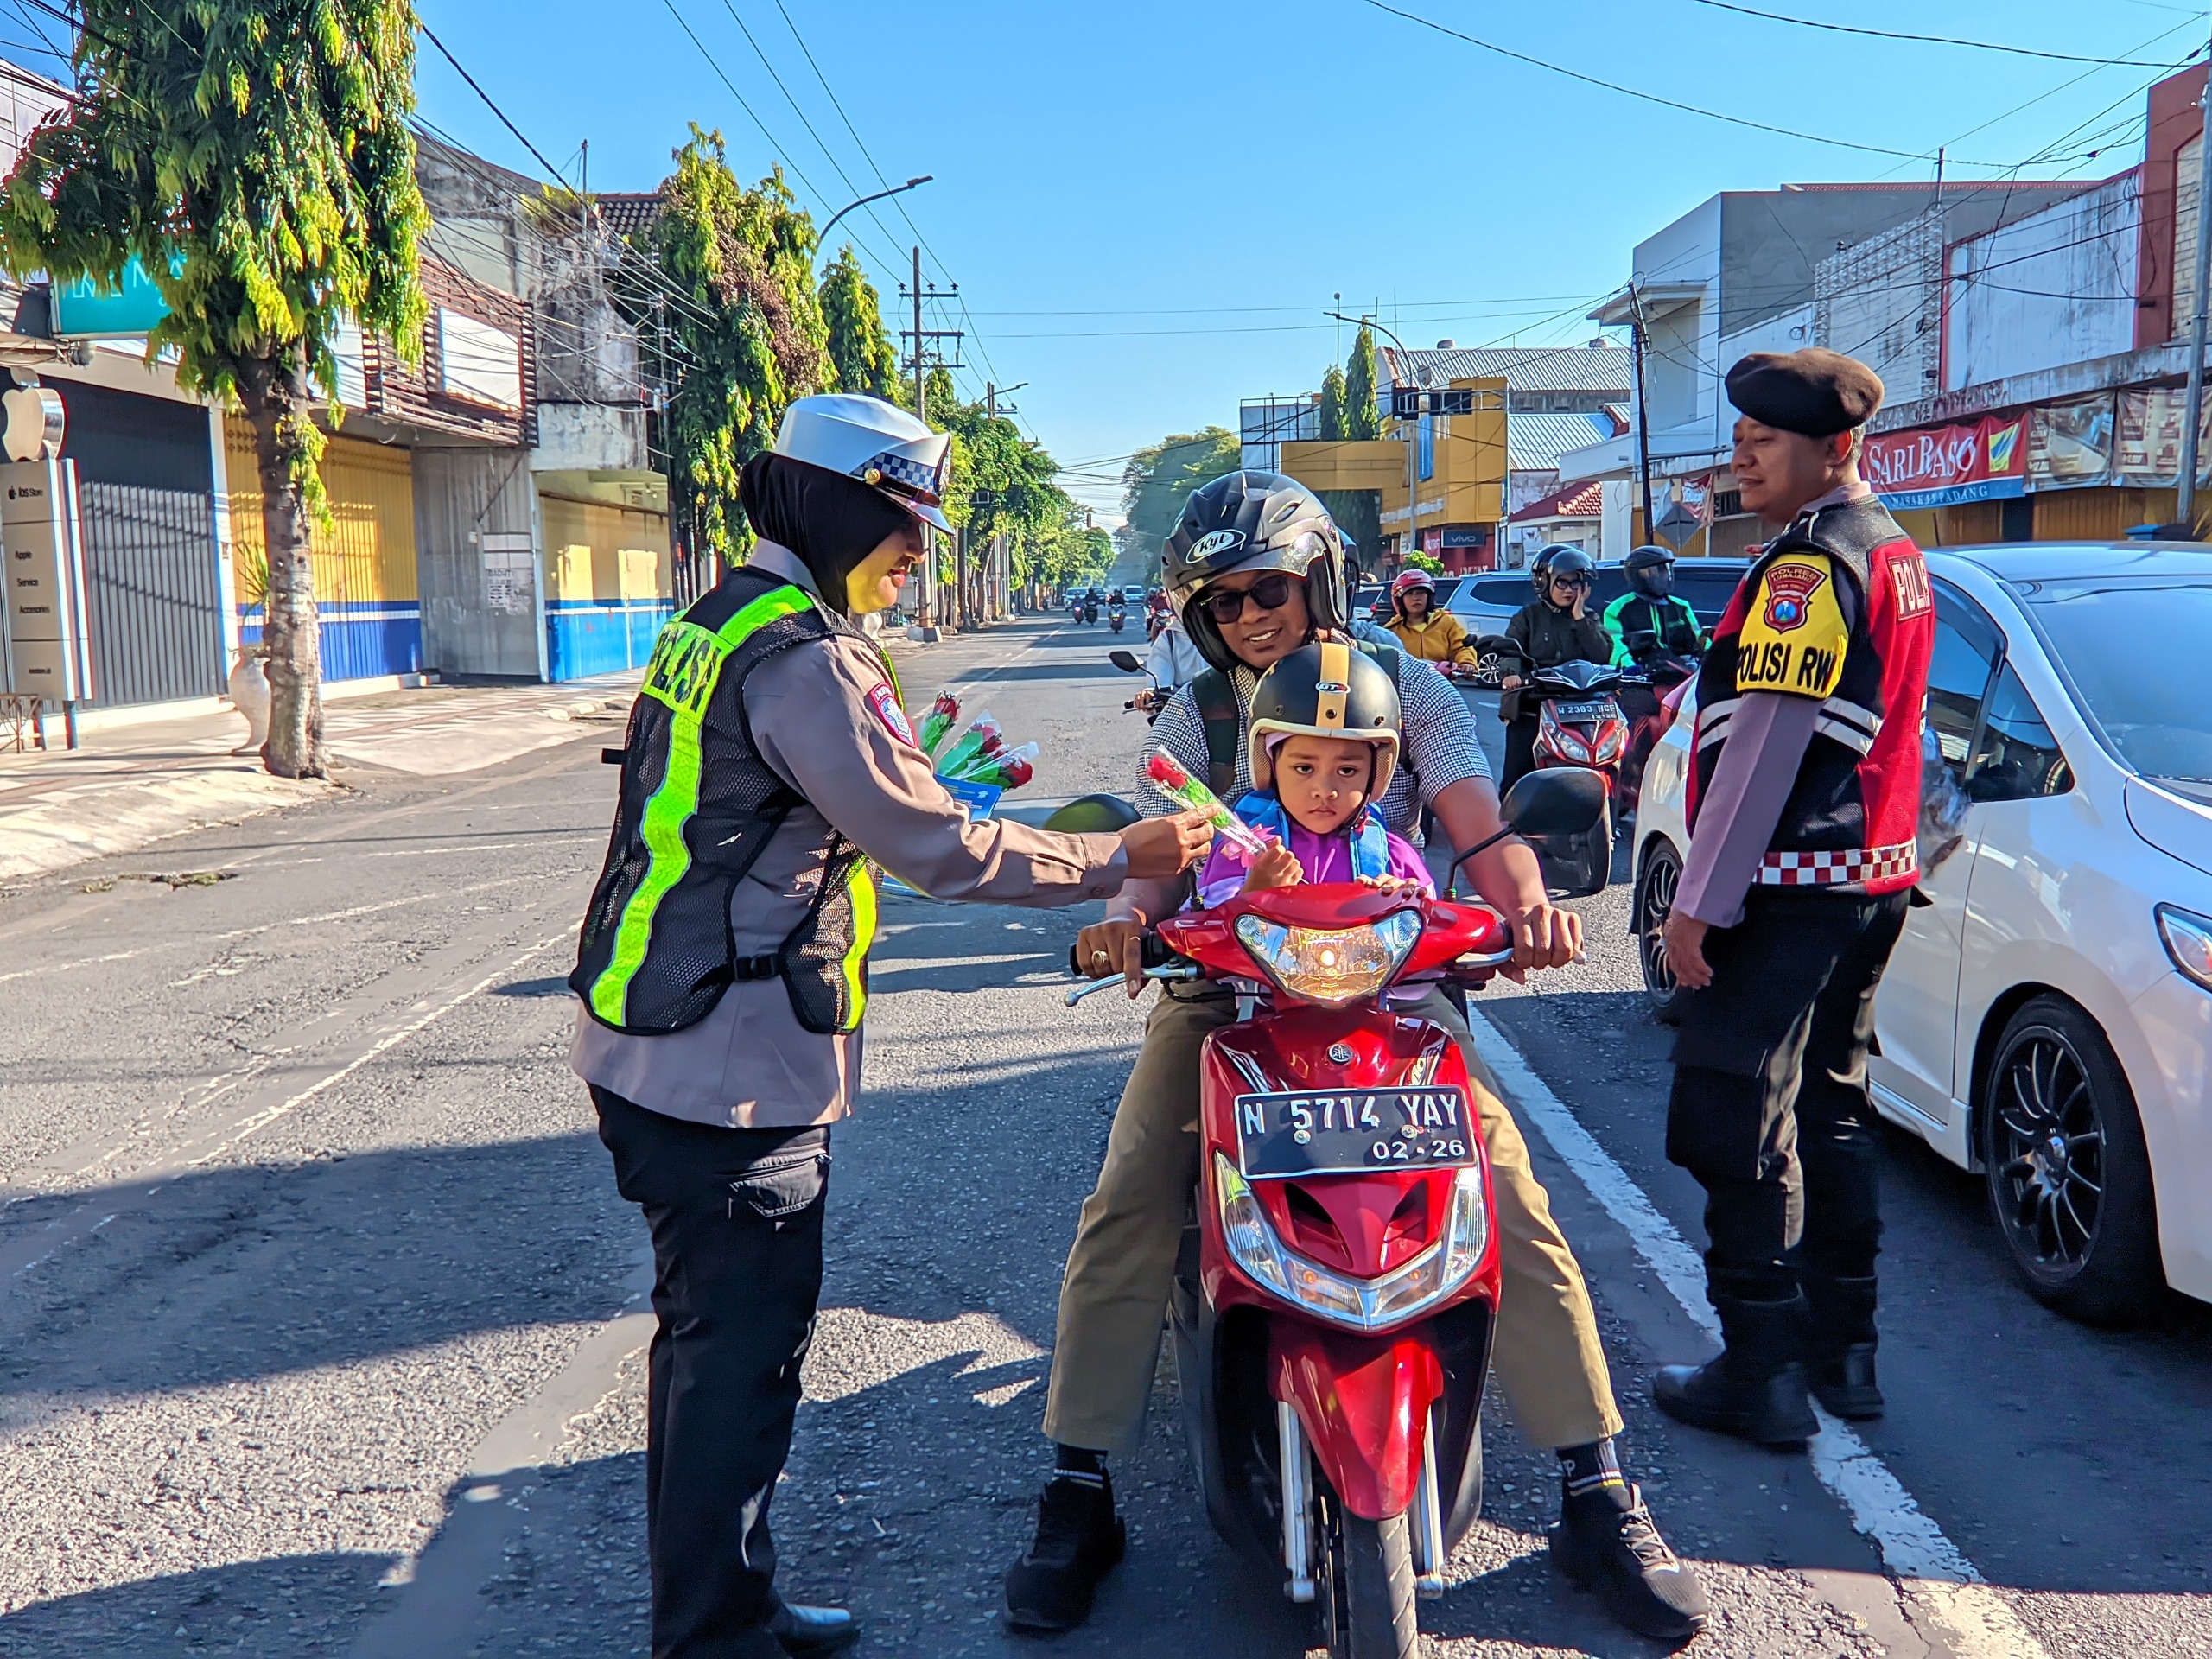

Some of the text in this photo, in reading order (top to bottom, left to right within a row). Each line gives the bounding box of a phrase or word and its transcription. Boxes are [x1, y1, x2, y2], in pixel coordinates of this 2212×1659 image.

[1868, 435, 1977, 486] SARI RASO
[1939, 486, 1987, 503] PADANG
[15, 550, 32, 560] Apple
[17, 578, 39, 587] Service
[1797, 646, 1837, 693] RW
[1558, 706, 1566, 715] W
[1567, 705, 1593, 714] 2383
[1243, 1094, 1458, 1135] N 5714 YAY
